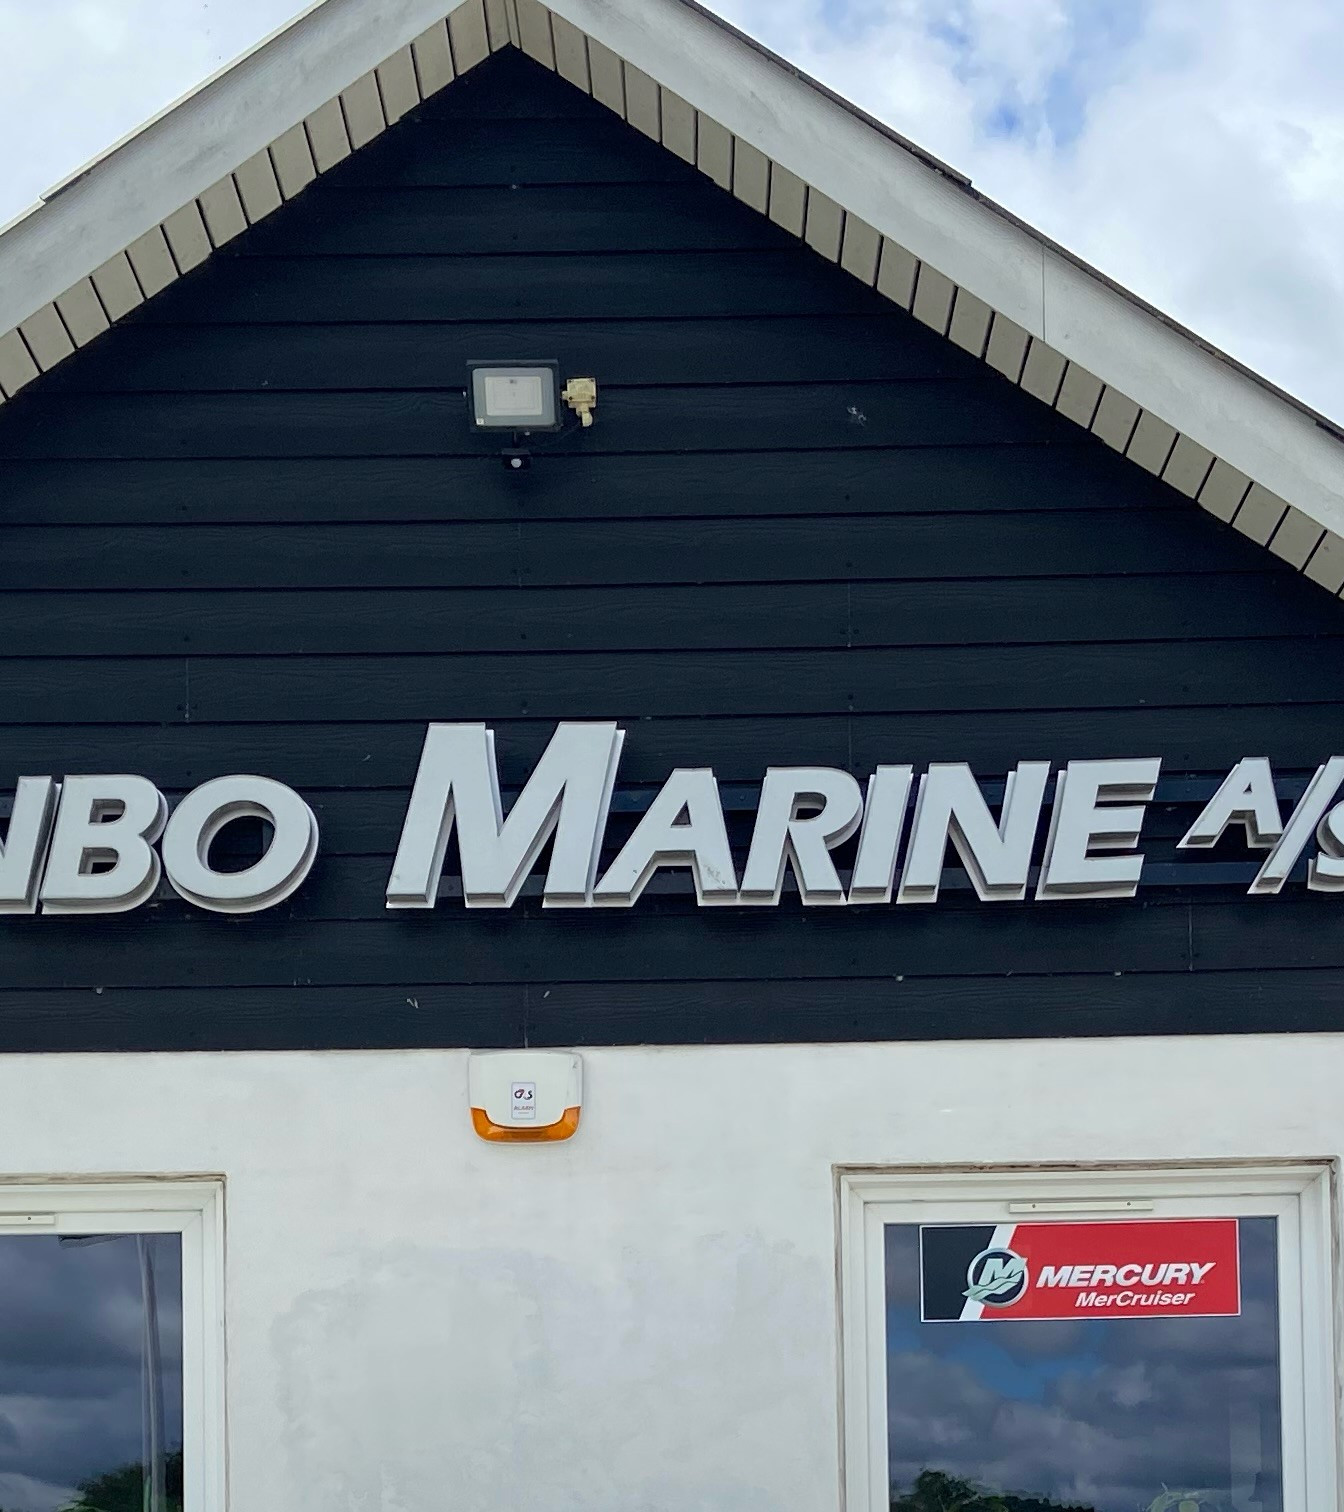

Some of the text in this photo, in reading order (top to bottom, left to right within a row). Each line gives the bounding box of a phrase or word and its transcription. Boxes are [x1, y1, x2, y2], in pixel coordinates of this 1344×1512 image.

[386, 721, 1163, 908] MARINE
[1036, 1262, 1216, 1288] MERCURY
[1075, 1290, 1196, 1308] MerCruiser
